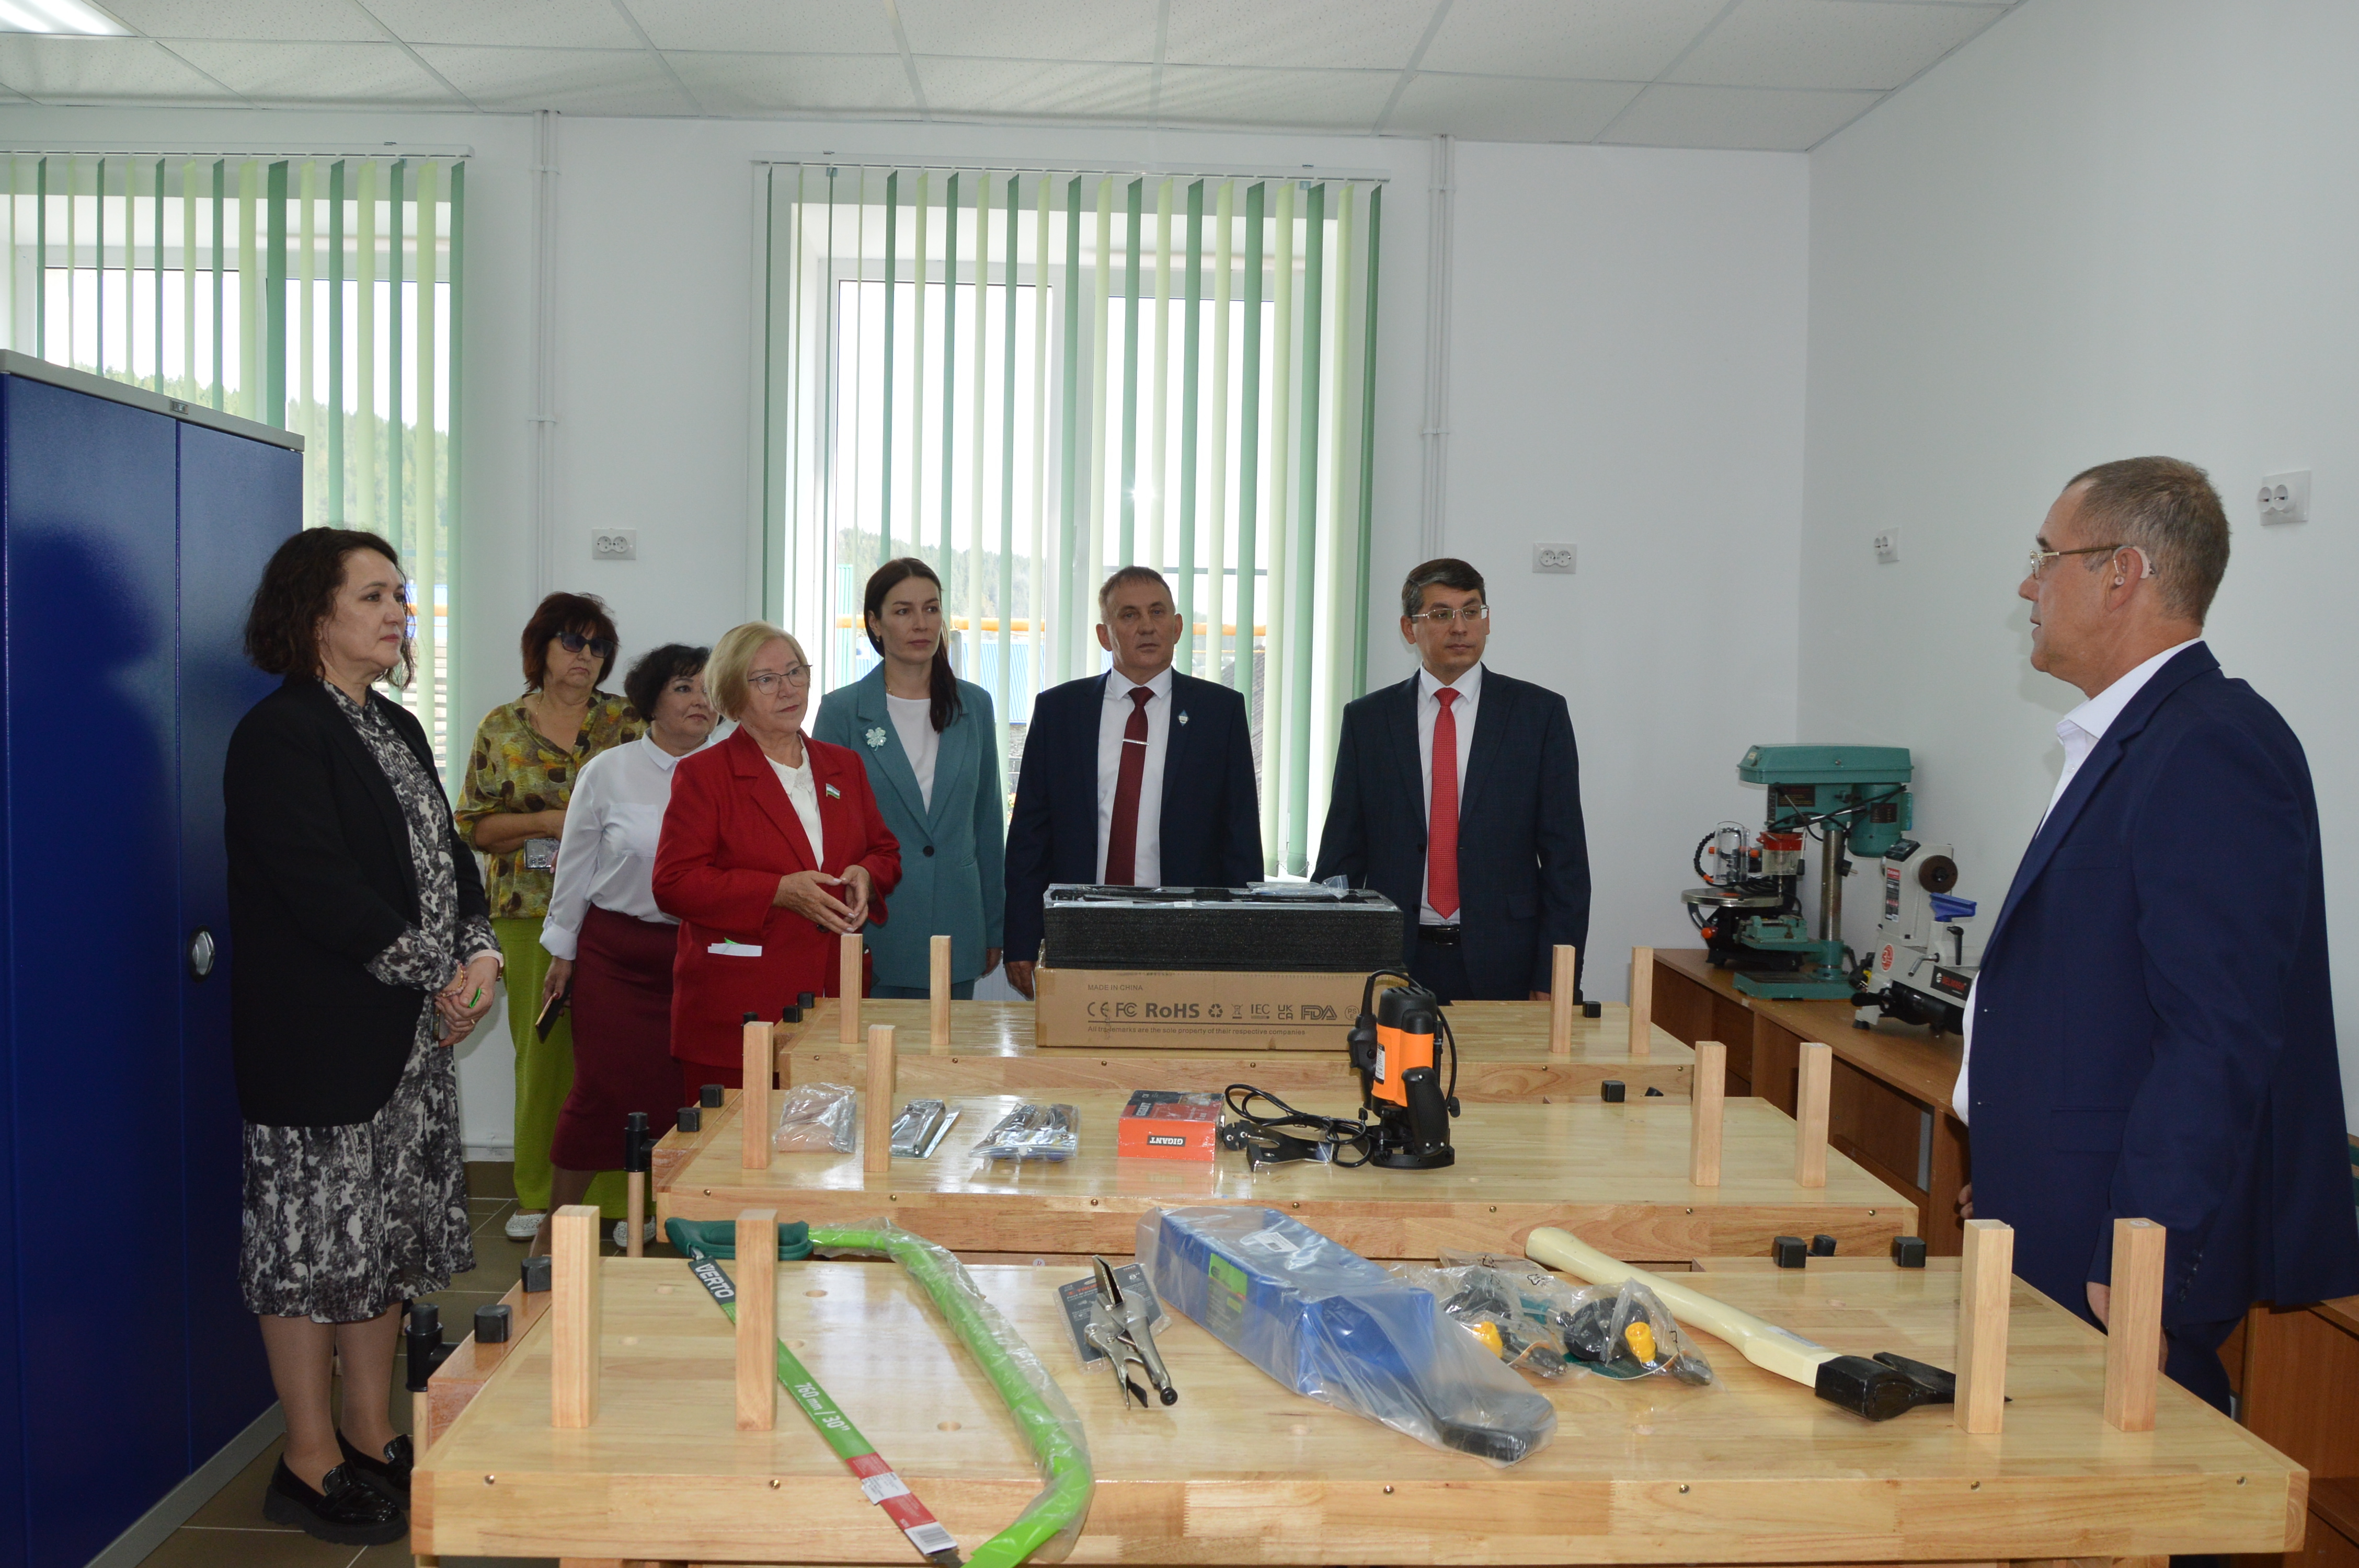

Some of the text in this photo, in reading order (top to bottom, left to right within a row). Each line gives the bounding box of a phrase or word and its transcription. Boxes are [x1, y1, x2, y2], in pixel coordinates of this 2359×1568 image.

[1146, 1002, 1200, 1018] RoHS
[1251, 1004, 1270, 1014] IEC
[1301, 1005, 1338, 1020] FDA
[1149, 1136, 1184, 1145] GIGANT
[695, 1263, 735, 1298] VERTO
[794, 1382, 820, 1398] 760
[806, 1398, 822, 1411] mm
